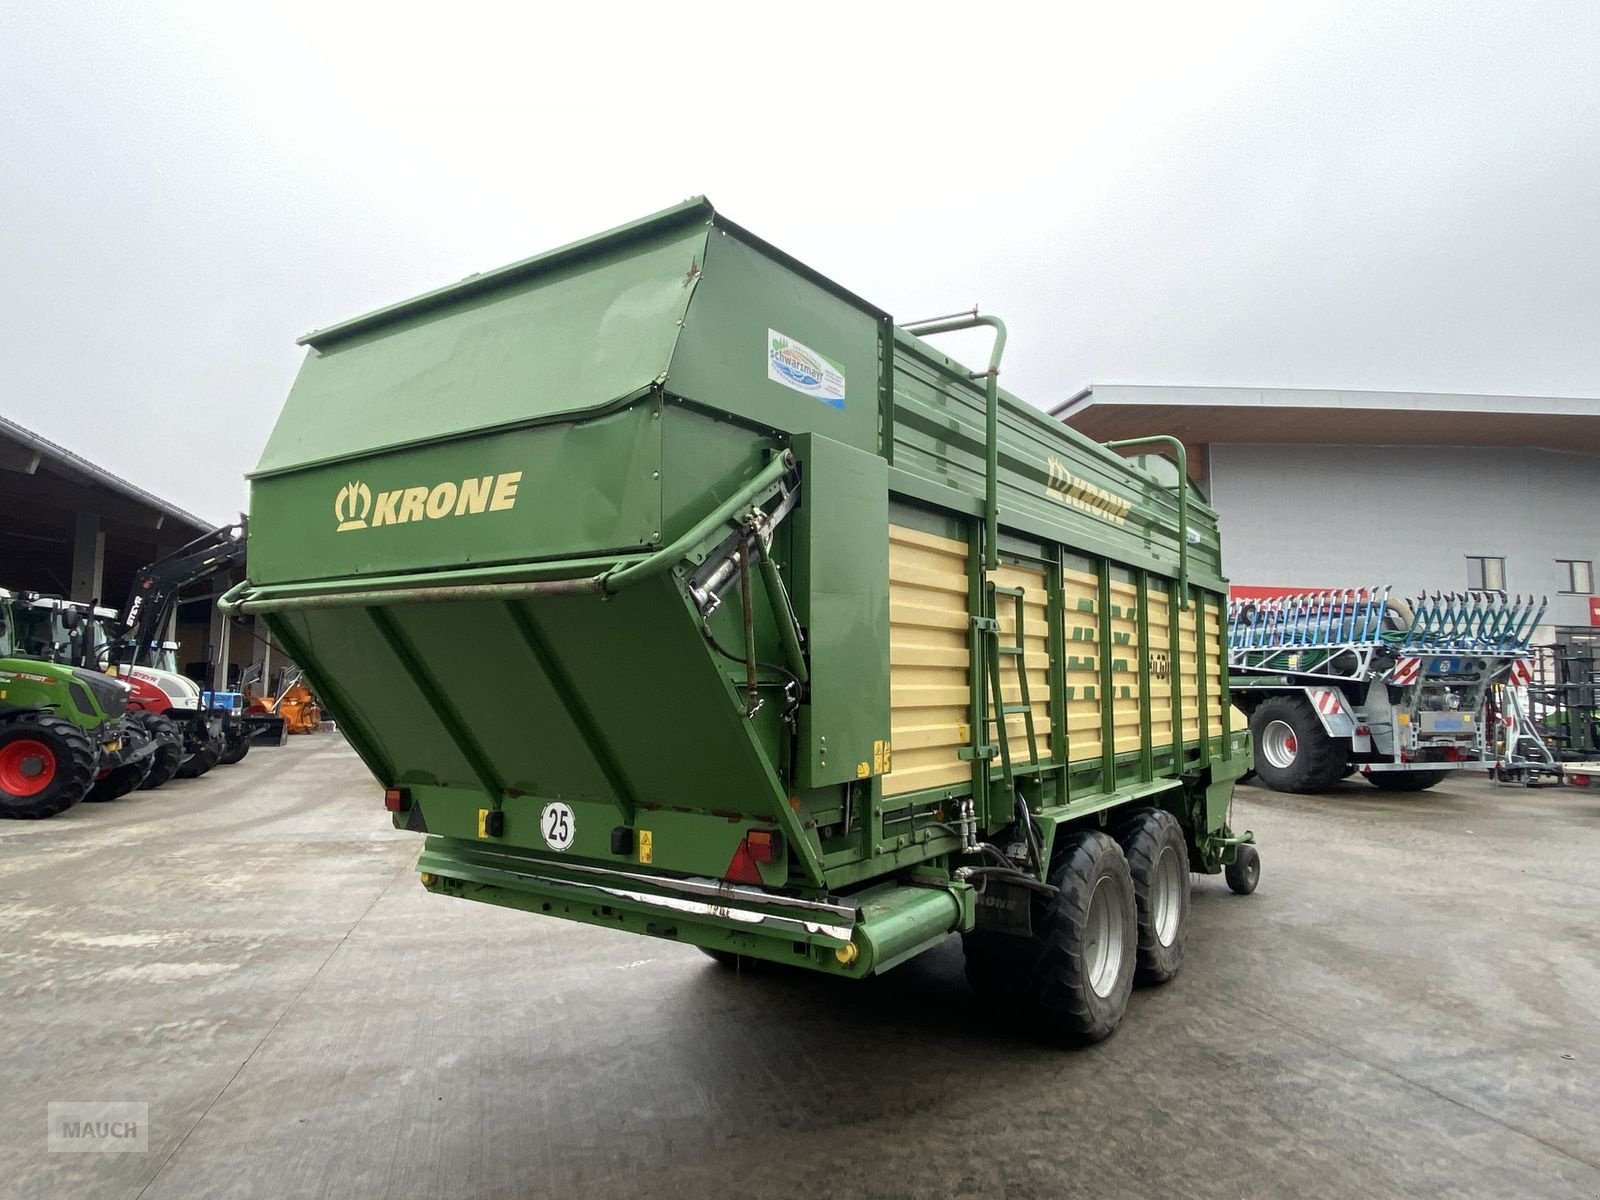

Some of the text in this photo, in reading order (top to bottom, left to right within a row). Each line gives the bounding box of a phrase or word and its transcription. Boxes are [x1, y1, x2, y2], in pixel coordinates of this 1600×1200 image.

[371, 471, 523, 527] KRONE
[1065, 476, 1132, 525] KRONE
[126, 596, 142, 627] STEYR
[132, 671, 157, 682] STEYR
[549, 808, 568, 842] 25
